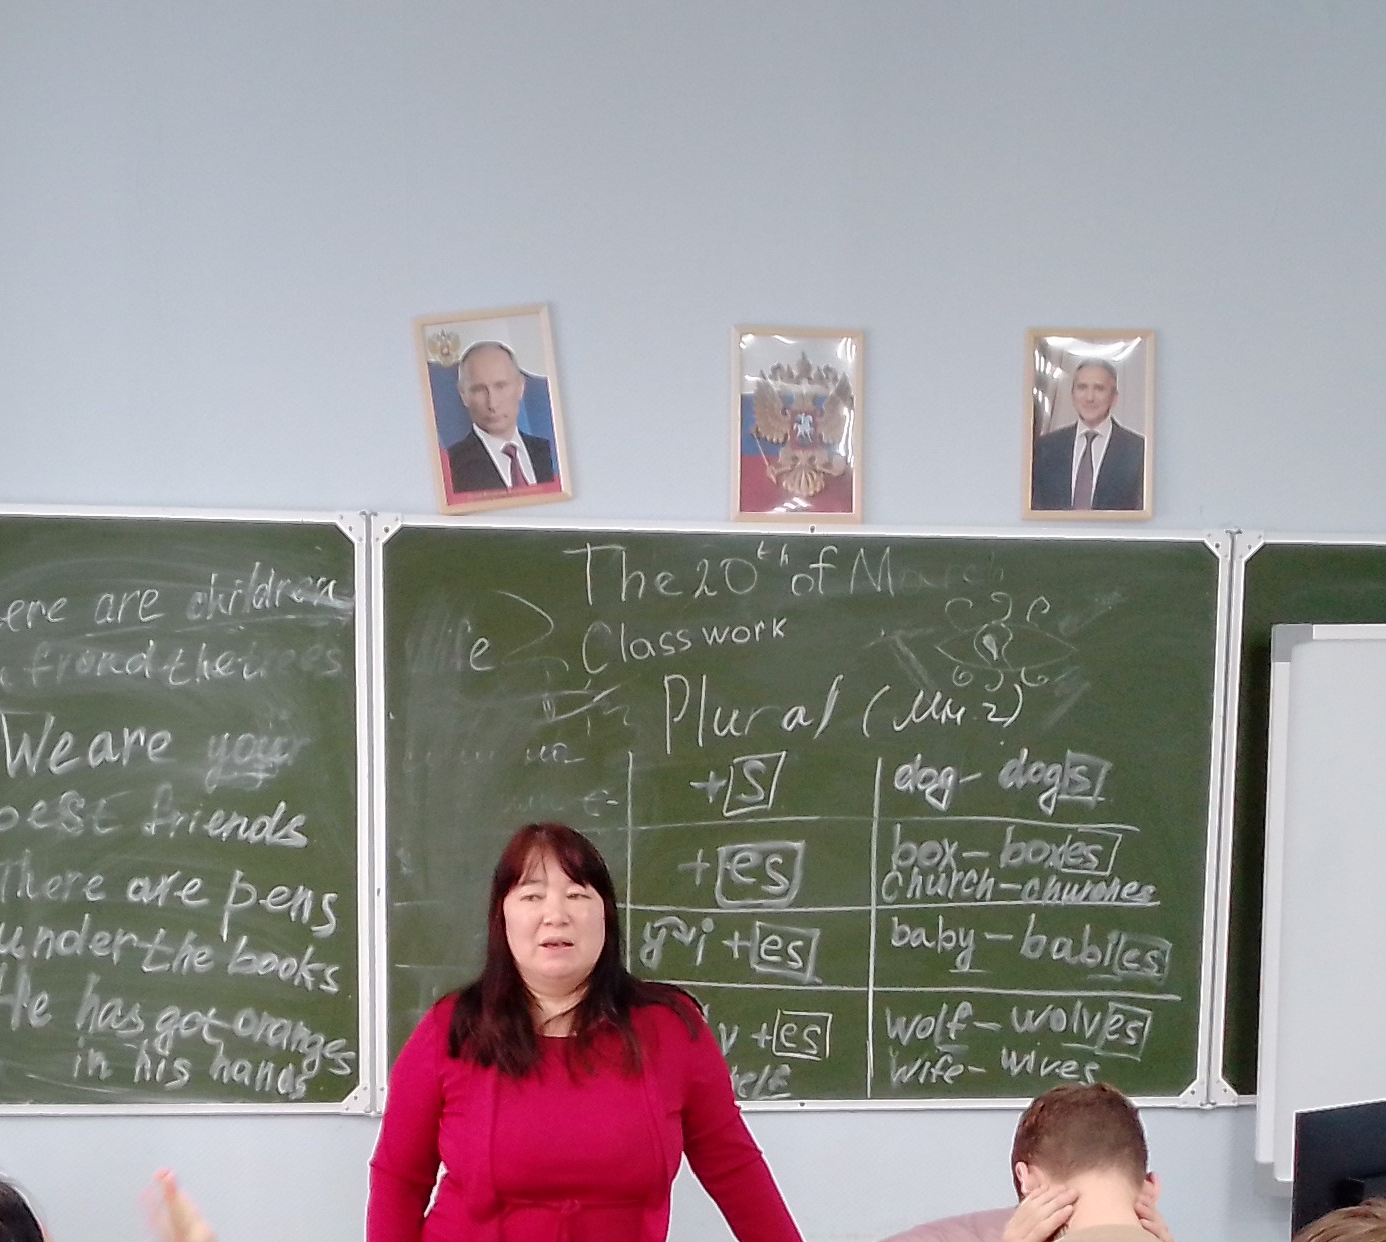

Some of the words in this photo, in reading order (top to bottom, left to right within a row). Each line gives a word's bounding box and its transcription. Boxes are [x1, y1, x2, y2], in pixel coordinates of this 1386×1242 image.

[563, 543, 682, 605] The
[791, 545, 838, 597] of
[94, 588, 164, 624] are
[663, 673, 844, 755] Plural
[88, 727, 175, 769] are
[893, 753, 956, 812] dog
[892, 823, 959, 872] box
[127, 870, 210, 907] are
[222, 869, 338, 942] pens
[140, 928, 213, 973] the
[227, 936, 340, 993] books
[891, 915, 976, 972] baby
[77, 972, 144, 1032] has
[233, 1006, 355, 1076] oranges
[886, 1000, 974, 1046] wolf
[133, 1040, 192, 1089] his
